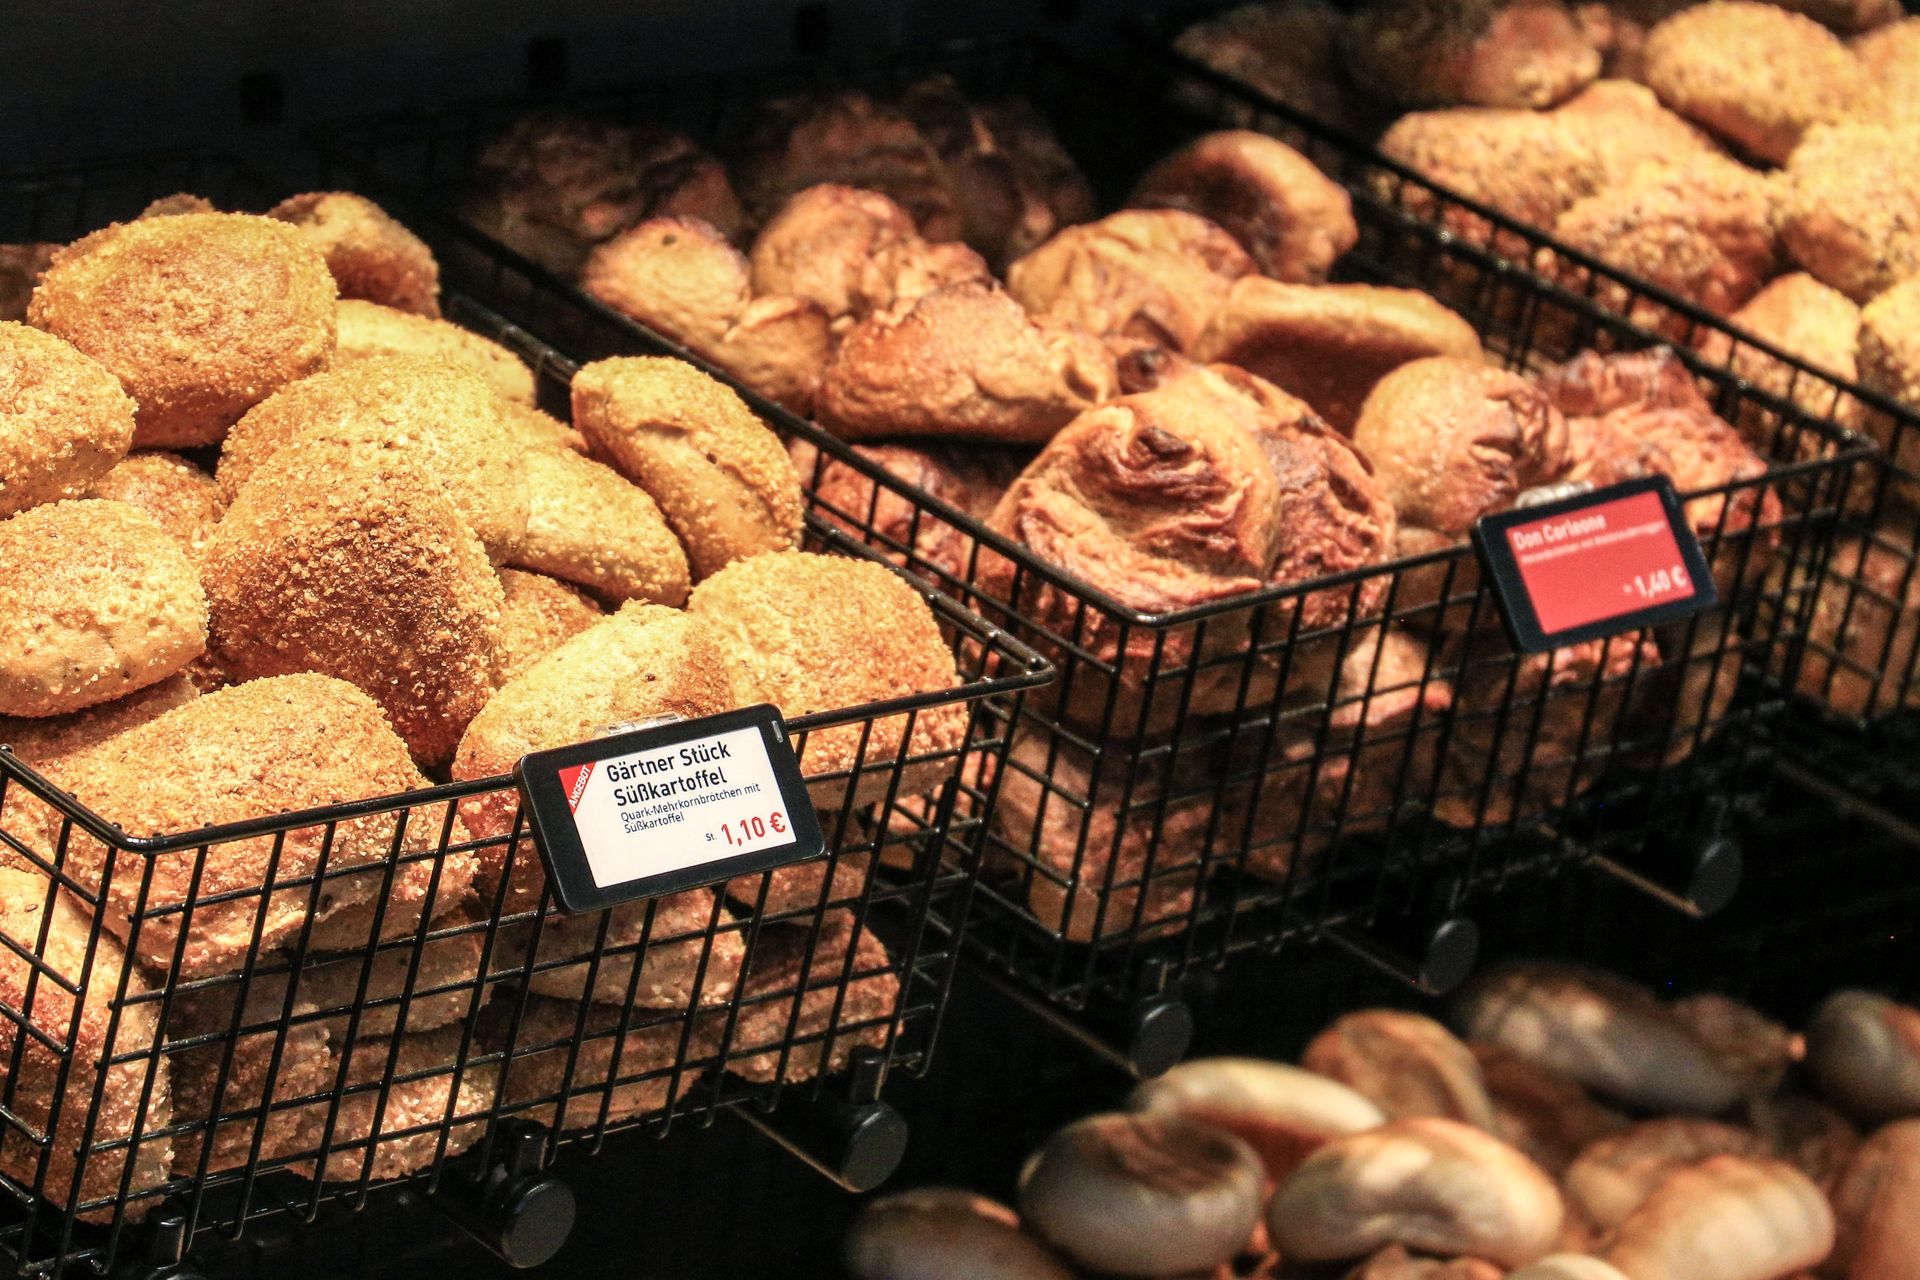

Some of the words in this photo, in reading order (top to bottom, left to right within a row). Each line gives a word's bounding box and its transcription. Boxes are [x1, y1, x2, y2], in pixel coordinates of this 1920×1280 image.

[1513, 530, 1543, 551] Don
[607, 755, 675, 782] Gärtner
[680, 741, 731, 767] Stück
[569, 764, 592, 807] ANGEBOT
[614, 767, 727, 806] Süßkartoffel
[621, 787, 742, 823] Quark-Mehrkornbrötchen
[744, 783, 761, 797] mit
[721, 816, 766, 847] 1,10
[770, 812, 786, 833] €
